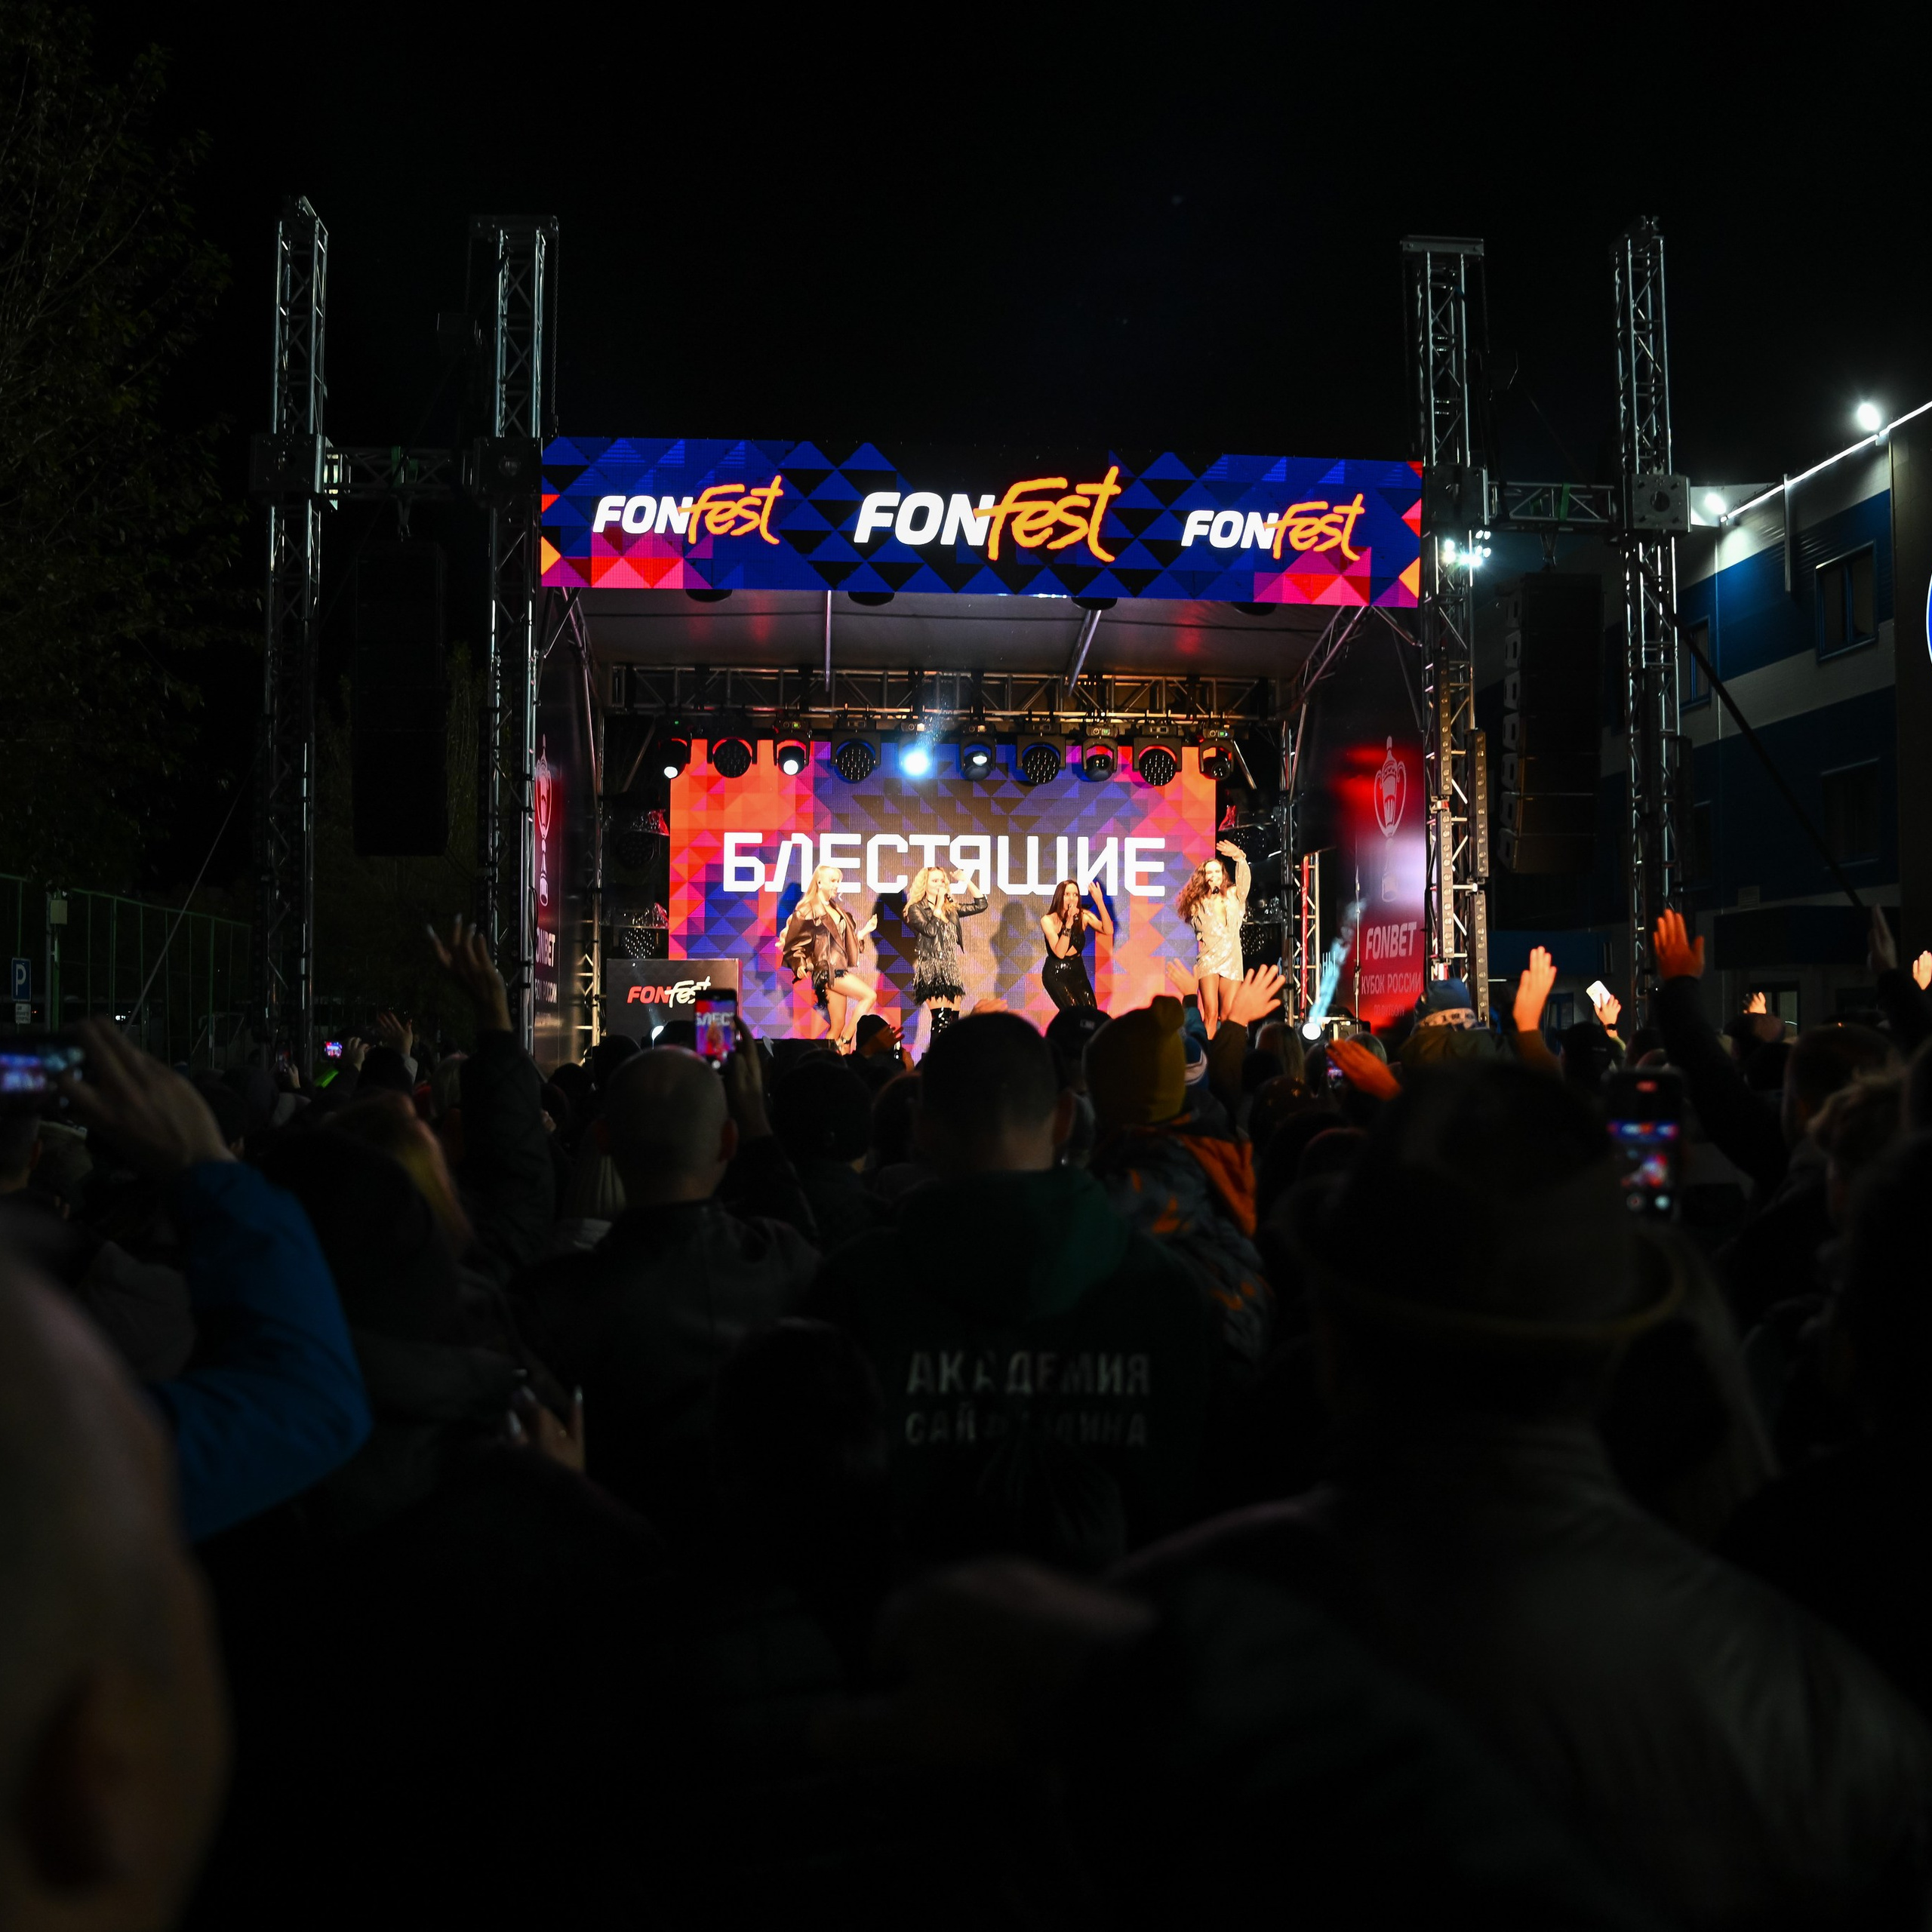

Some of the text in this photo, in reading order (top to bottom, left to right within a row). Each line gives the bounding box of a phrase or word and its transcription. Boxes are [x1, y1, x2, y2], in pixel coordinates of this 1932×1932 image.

[723, 832, 1165, 897] БЛЕСТЯЩИЕ
[535, 926, 556, 968] ONBET
[1365, 921, 1417, 961] FONBET
[16, 964, 26, 996] P
[1361, 971, 1422, 995] КУБОК РОССИИ
[906, 1349, 1152, 1395] АКАДЕМИЯ
